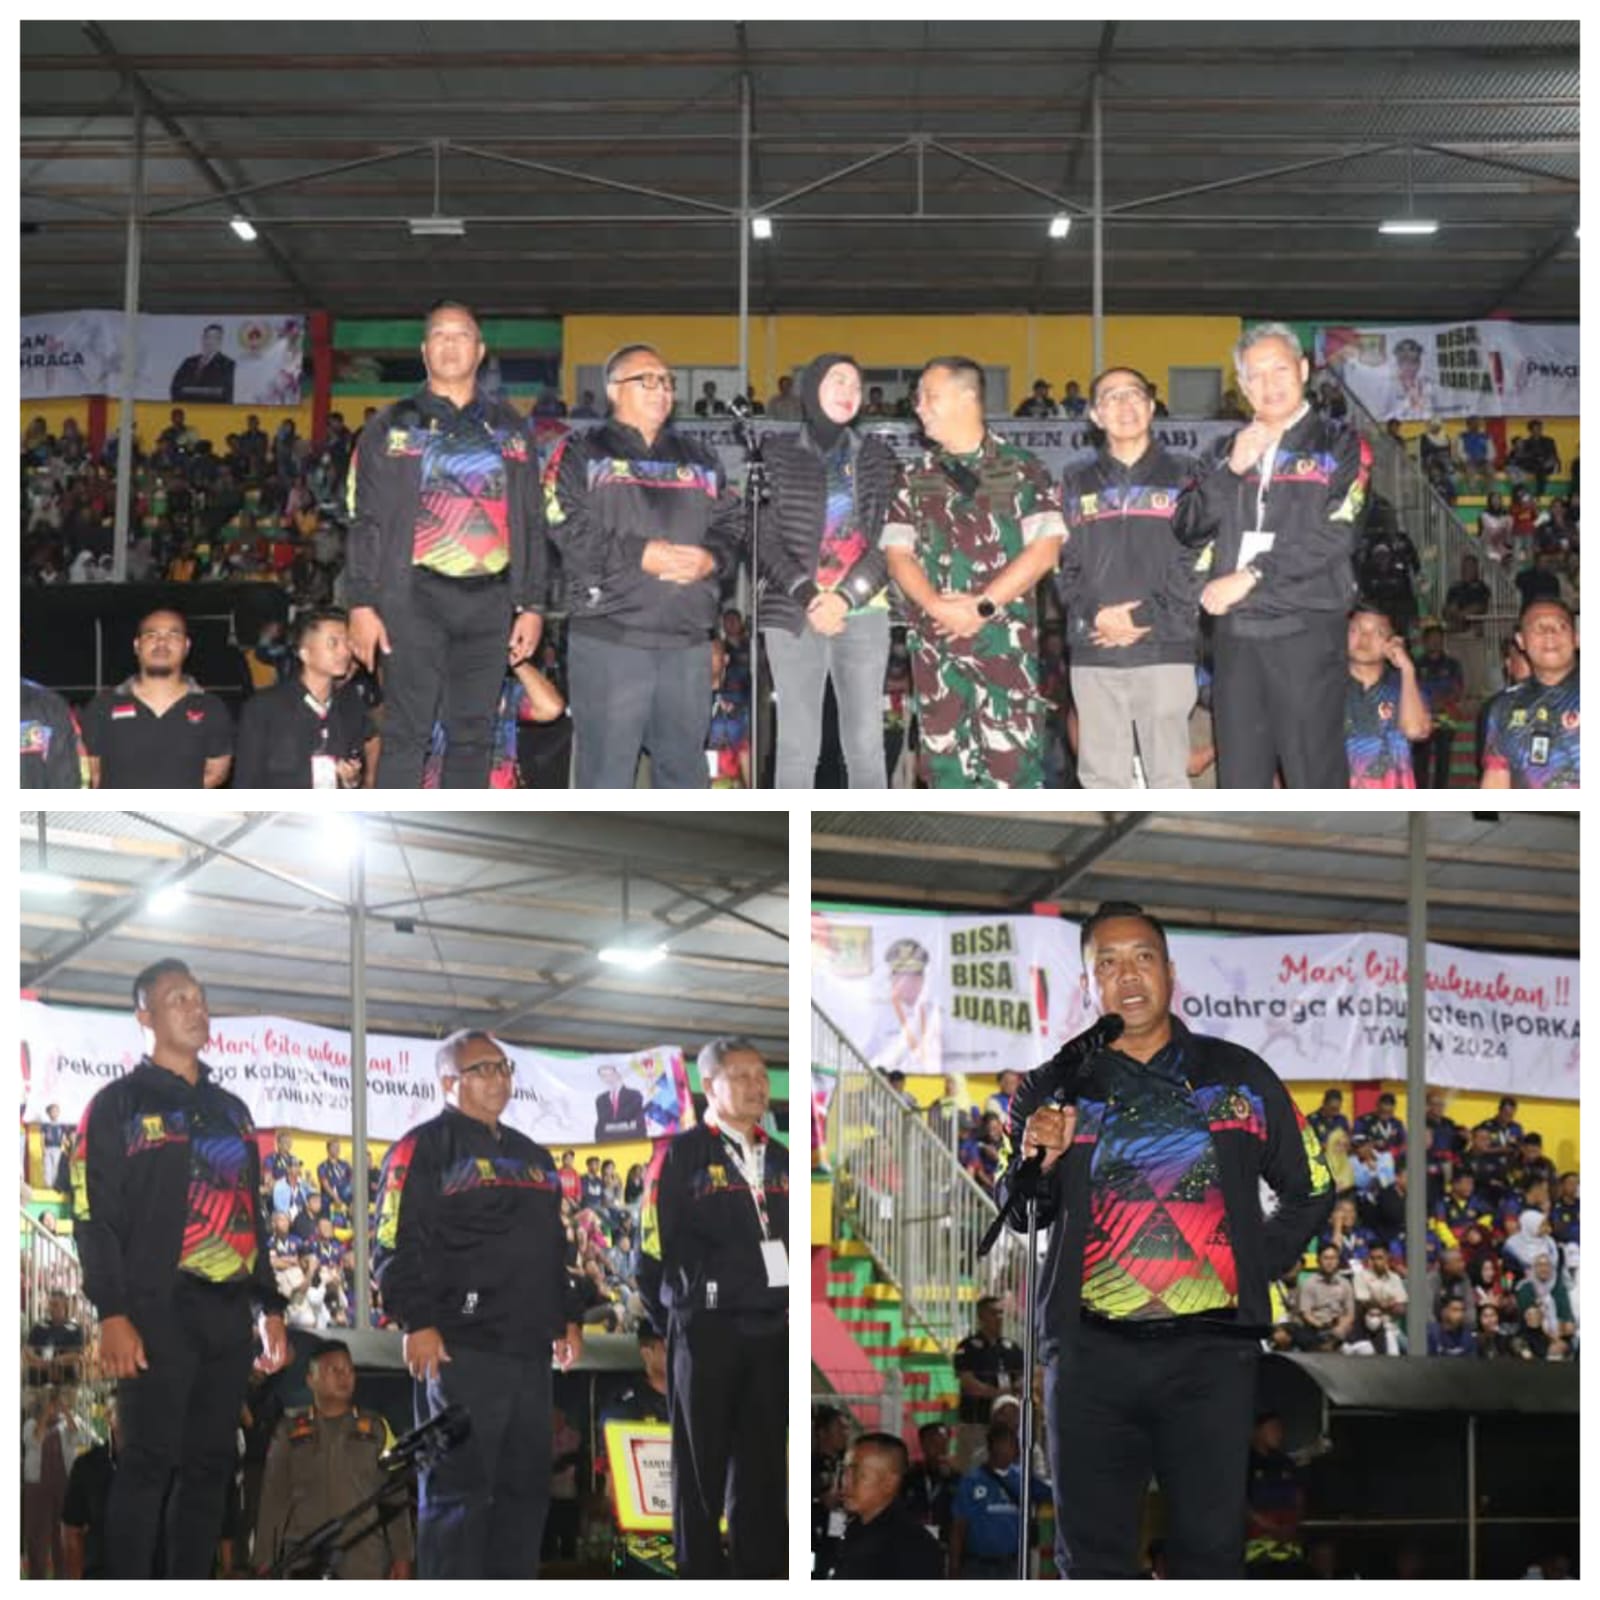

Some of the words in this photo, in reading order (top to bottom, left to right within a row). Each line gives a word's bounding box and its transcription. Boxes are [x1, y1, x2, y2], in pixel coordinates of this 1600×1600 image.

[951, 922, 1013, 956] BISA
[951, 961, 1013, 990] BISA
[1278, 953, 1356, 985] Mari
[951, 994, 1033, 1034] JUARA
[1182, 992, 1327, 1024] Olahraga
[1337, 993, 1485, 1030] Kabuaten
[1362, 1025, 1444, 1053] TAHN
[1452, 1035, 1509, 1059] 2024
[57, 1054, 126, 1079] Pekan
